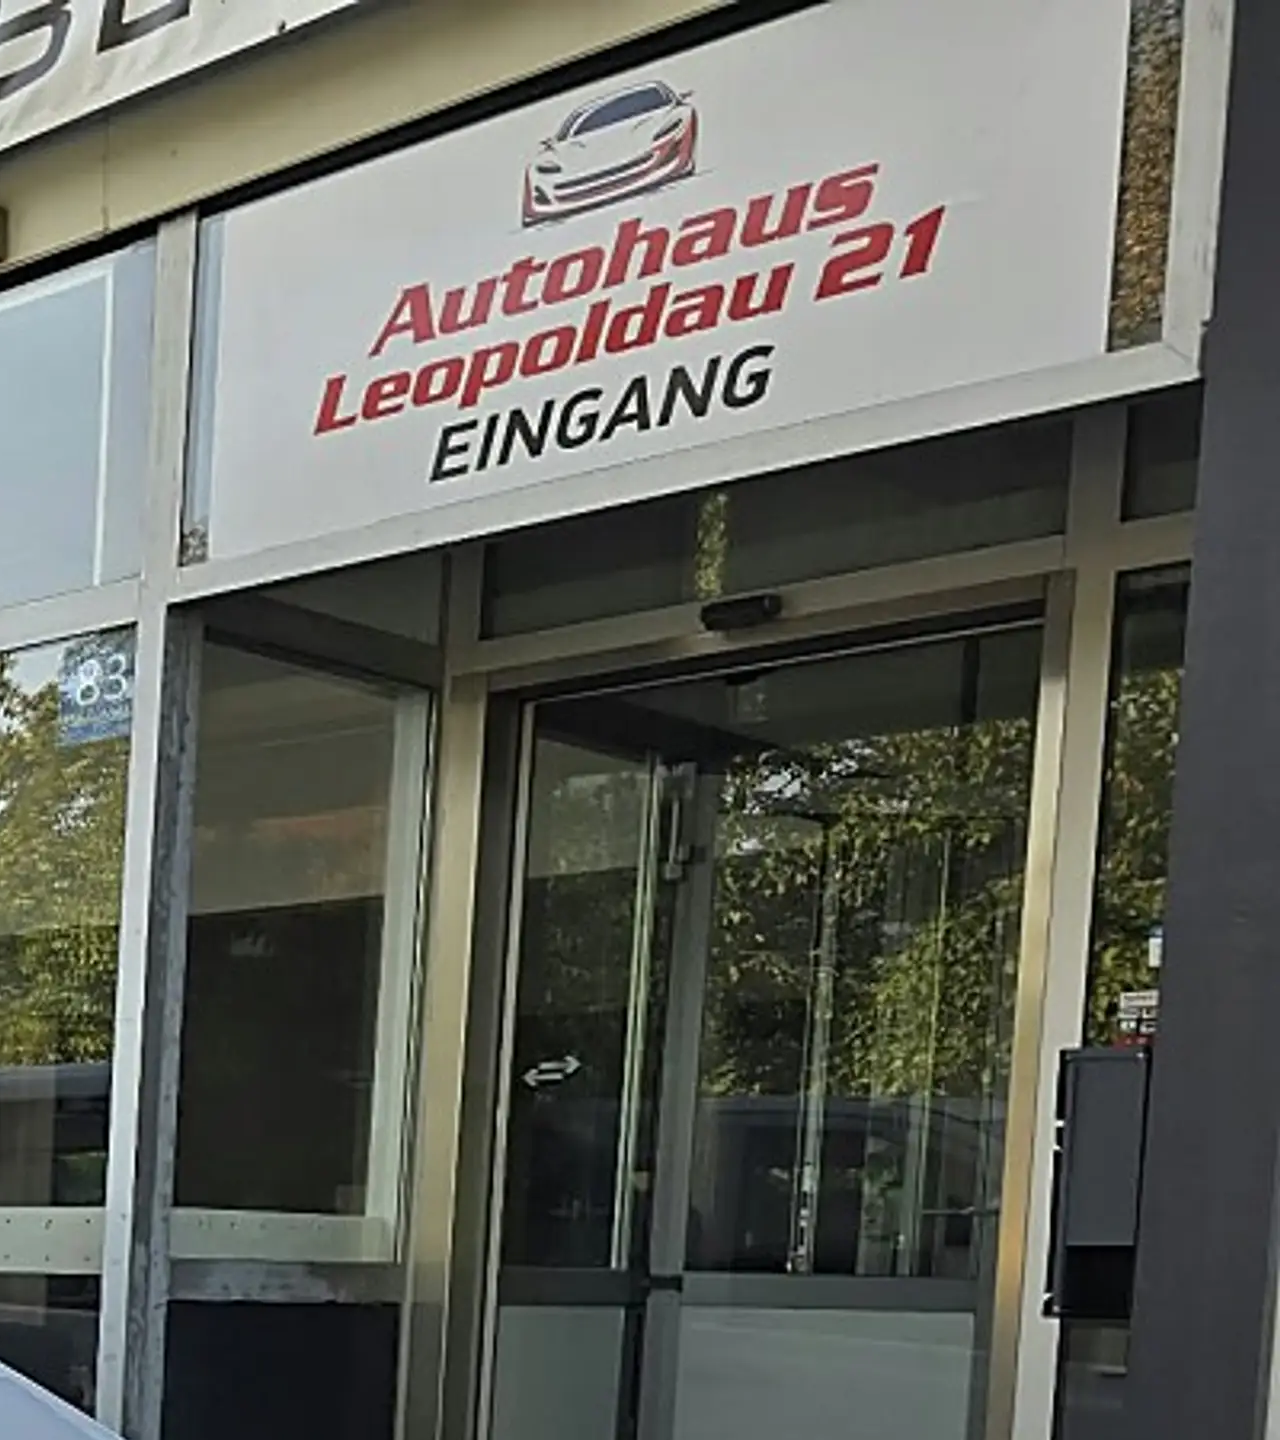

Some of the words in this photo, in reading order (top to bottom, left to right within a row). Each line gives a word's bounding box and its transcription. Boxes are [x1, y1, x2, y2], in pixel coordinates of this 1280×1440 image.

[313, 263, 795, 435] Leopoldau
[814, 205, 945, 301] 21
[368, 163, 879, 358] Autohaus
[428, 345, 775, 483] EINGANG
